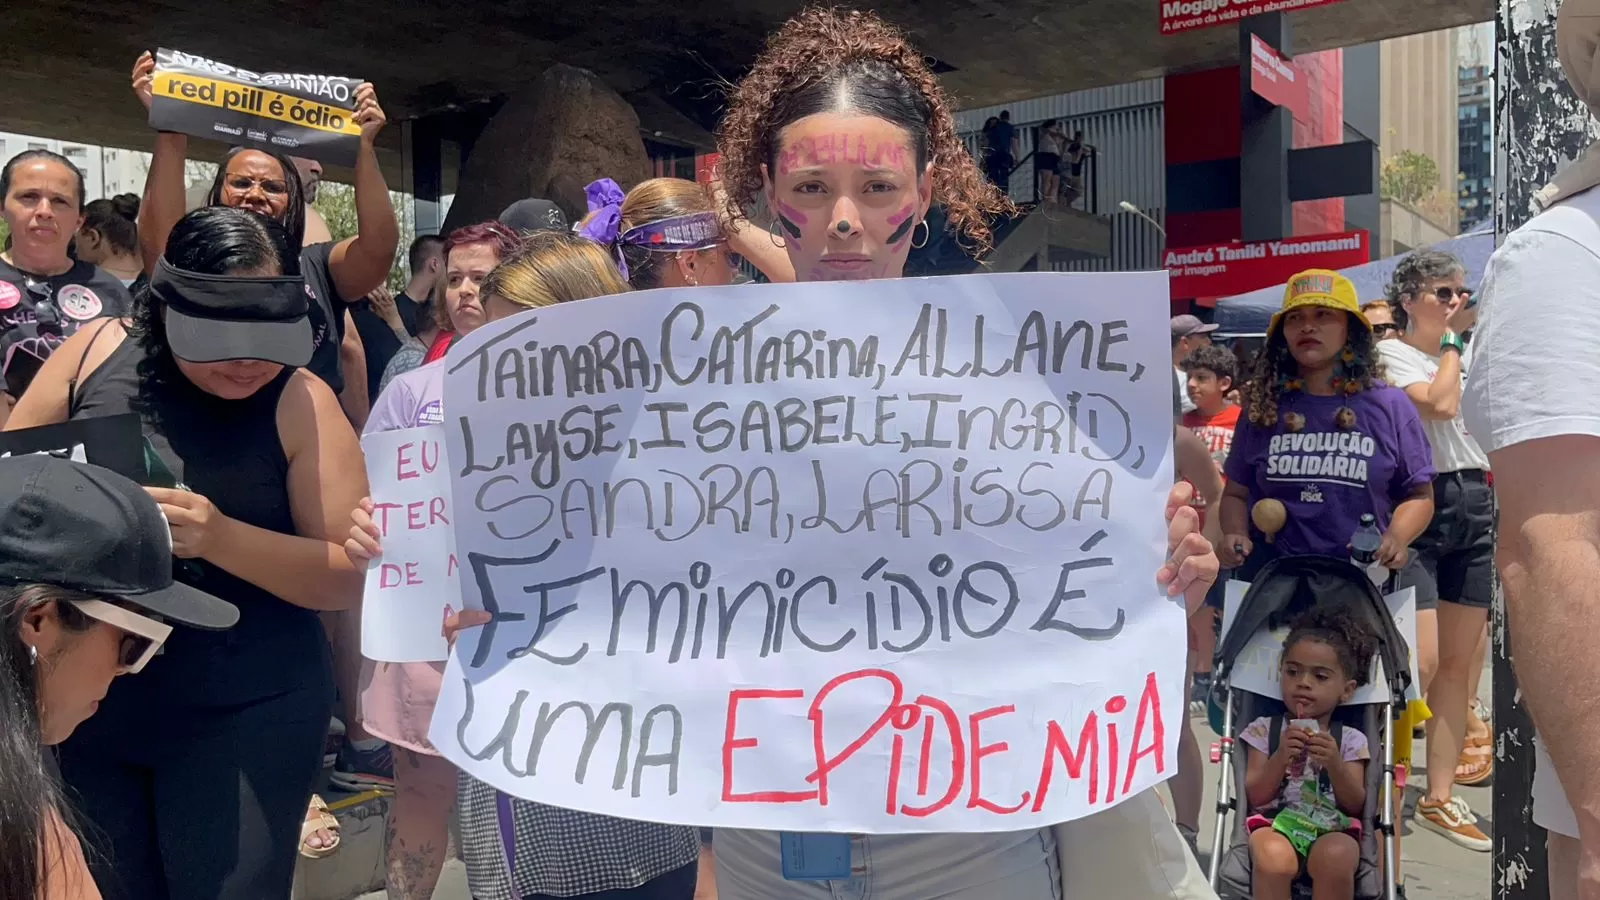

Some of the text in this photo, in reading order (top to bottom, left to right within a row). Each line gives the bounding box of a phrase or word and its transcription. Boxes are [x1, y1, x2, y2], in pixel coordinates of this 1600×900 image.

[1162, 22, 1171, 32] A
[1204, 12, 1217, 23] da
[1219, 8, 1239, 21] vida
[1250, 4, 1262, 15] da
[168, 77, 345, 130] red pill é ódio
[1165, 234, 1361, 267] André Taniki Yanomami
[1184, 263, 1227, 277] imagem
[1268, 431, 1375, 458] REVOLUÇÃO
[397, 440, 438, 481] EU
[1266, 452, 1368, 482] SOLIDÁRIA
[380, 562, 423, 589] DE
[1029, 529, 1125, 642] É
